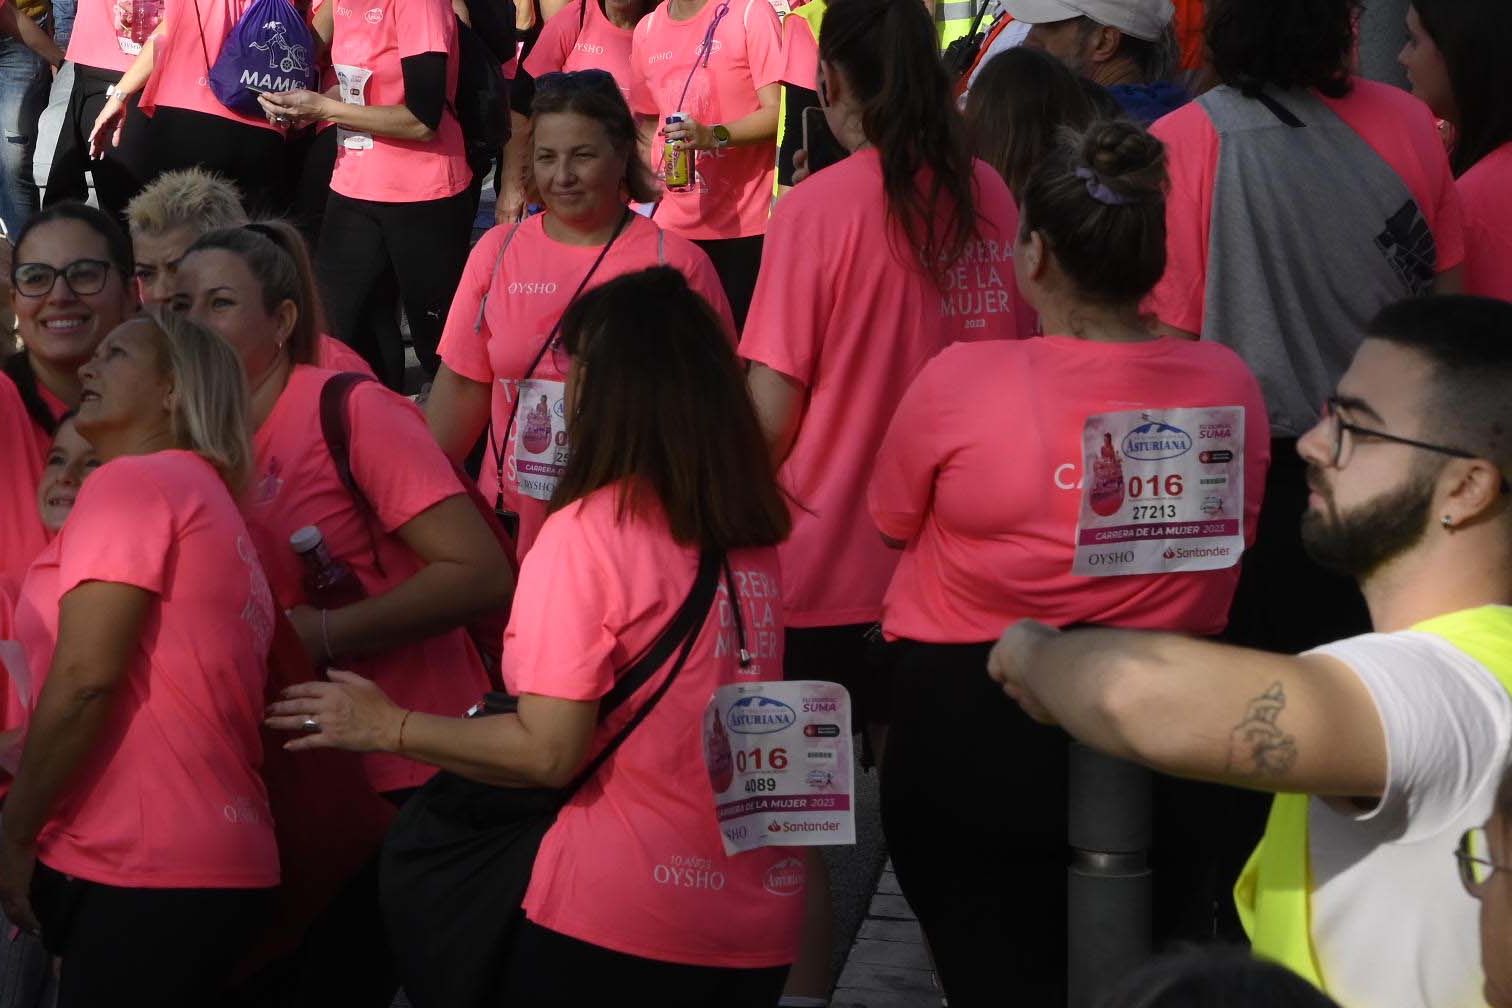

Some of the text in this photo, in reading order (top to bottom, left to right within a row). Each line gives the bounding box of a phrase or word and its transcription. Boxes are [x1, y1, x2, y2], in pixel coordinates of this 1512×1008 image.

[976, 265, 1003, 289] LA
[940, 290, 1010, 318] MUJER
[1199, 429, 1232, 439] SUMA
[1126, 441, 1187, 453] ASTURIANA
[1128, 474, 1183, 498] 016
[1133, 505, 1176, 520] 27213
[1095, 524, 1225, 541] CARRERA DE LA MUJER 2023
[1088, 551, 1135, 566] OYSHO
[1176, 547, 1231, 558] Santander
[752, 602, 775, 628] LA
[802, 703, 837, 713] SUMA
[730, 711, 789, 726] ASTURIANA
[736, 748, 788, 771] 016
[744, 778, 776, 793] 4089
[755, 799, 768, 809] LA
[771, 798, 807, 809] MUJER
[811, 798, 835, 807] 2023
[783, 821, 841, 832] Santander
[654, 864, 725, 891] OYSHO
